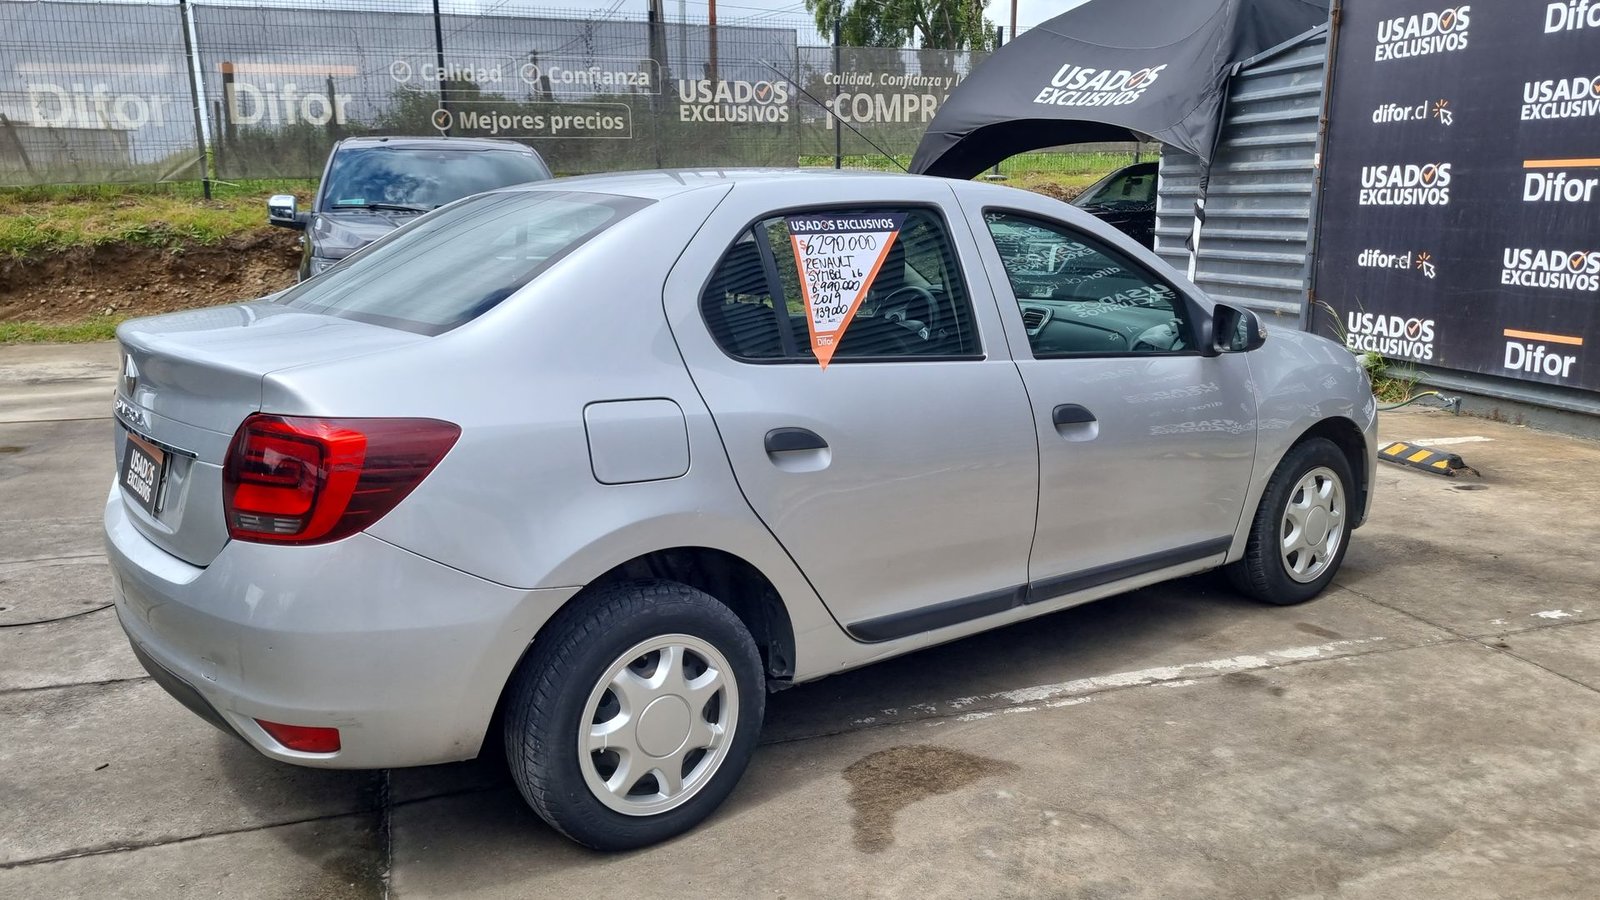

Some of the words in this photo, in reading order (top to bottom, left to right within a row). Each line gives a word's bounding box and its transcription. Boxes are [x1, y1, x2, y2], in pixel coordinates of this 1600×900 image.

[1377, 6, 1470, 43] USADOS
[1375, 32, 1468, 62] EXCLUSIVOS
[420, 63, 503, 83] Calidad
[548, 66, 650, 86] Confianza
[824, 72, 875, 87] Calidad,
[879, 73, 941, 87] Confianza
[944, 76, 953, 90] y
[955, 74, 965, 87] l
[1053, 63, 1168, 92] USADOS
[226, 82, 353, 125] Difor
[678, 80, 788, 104] USADOS
[1033, 86, 1147, 107] EXCLUSIVOS
[28, 83, 172, 128] Difor
[680, 104, 789, 122] EXCLUSIVOS
[825, 92, 951, 130] ¡COMPR
[1372, 101, 1428, 123] difor.cl
[1520, 99, 1600, 120] EXCLUSIV
[459, 111, 545, 134] Mejores
[551, 113, 625, 134] precios
[1361, 163, 1452, 188] USADOS
[1523, 172, 1599, 201] Difor
[1359, 188, 1450, 206] EXCLUSIVOS
[790, 220, 835, 231] USADOS
[837, 218, 895, 230] EXCLUSIVOS
[805, 255, 855, 273] RENAULT
[1358, 249, 1412, 269] difor.cl
[1503, 248, 1600, 274] USADOS
[1501, 269, 1600, 291] EXCLUSIVOS
[813, 291, 841, 306] 2019
[1347, 311, 1435, 342] USADOS
[1346, 333, 1434, 360] EXCLUSIVOS
[1504, 341, 1576, 378] Difor
[130, 448, 155, 486] USADOS
